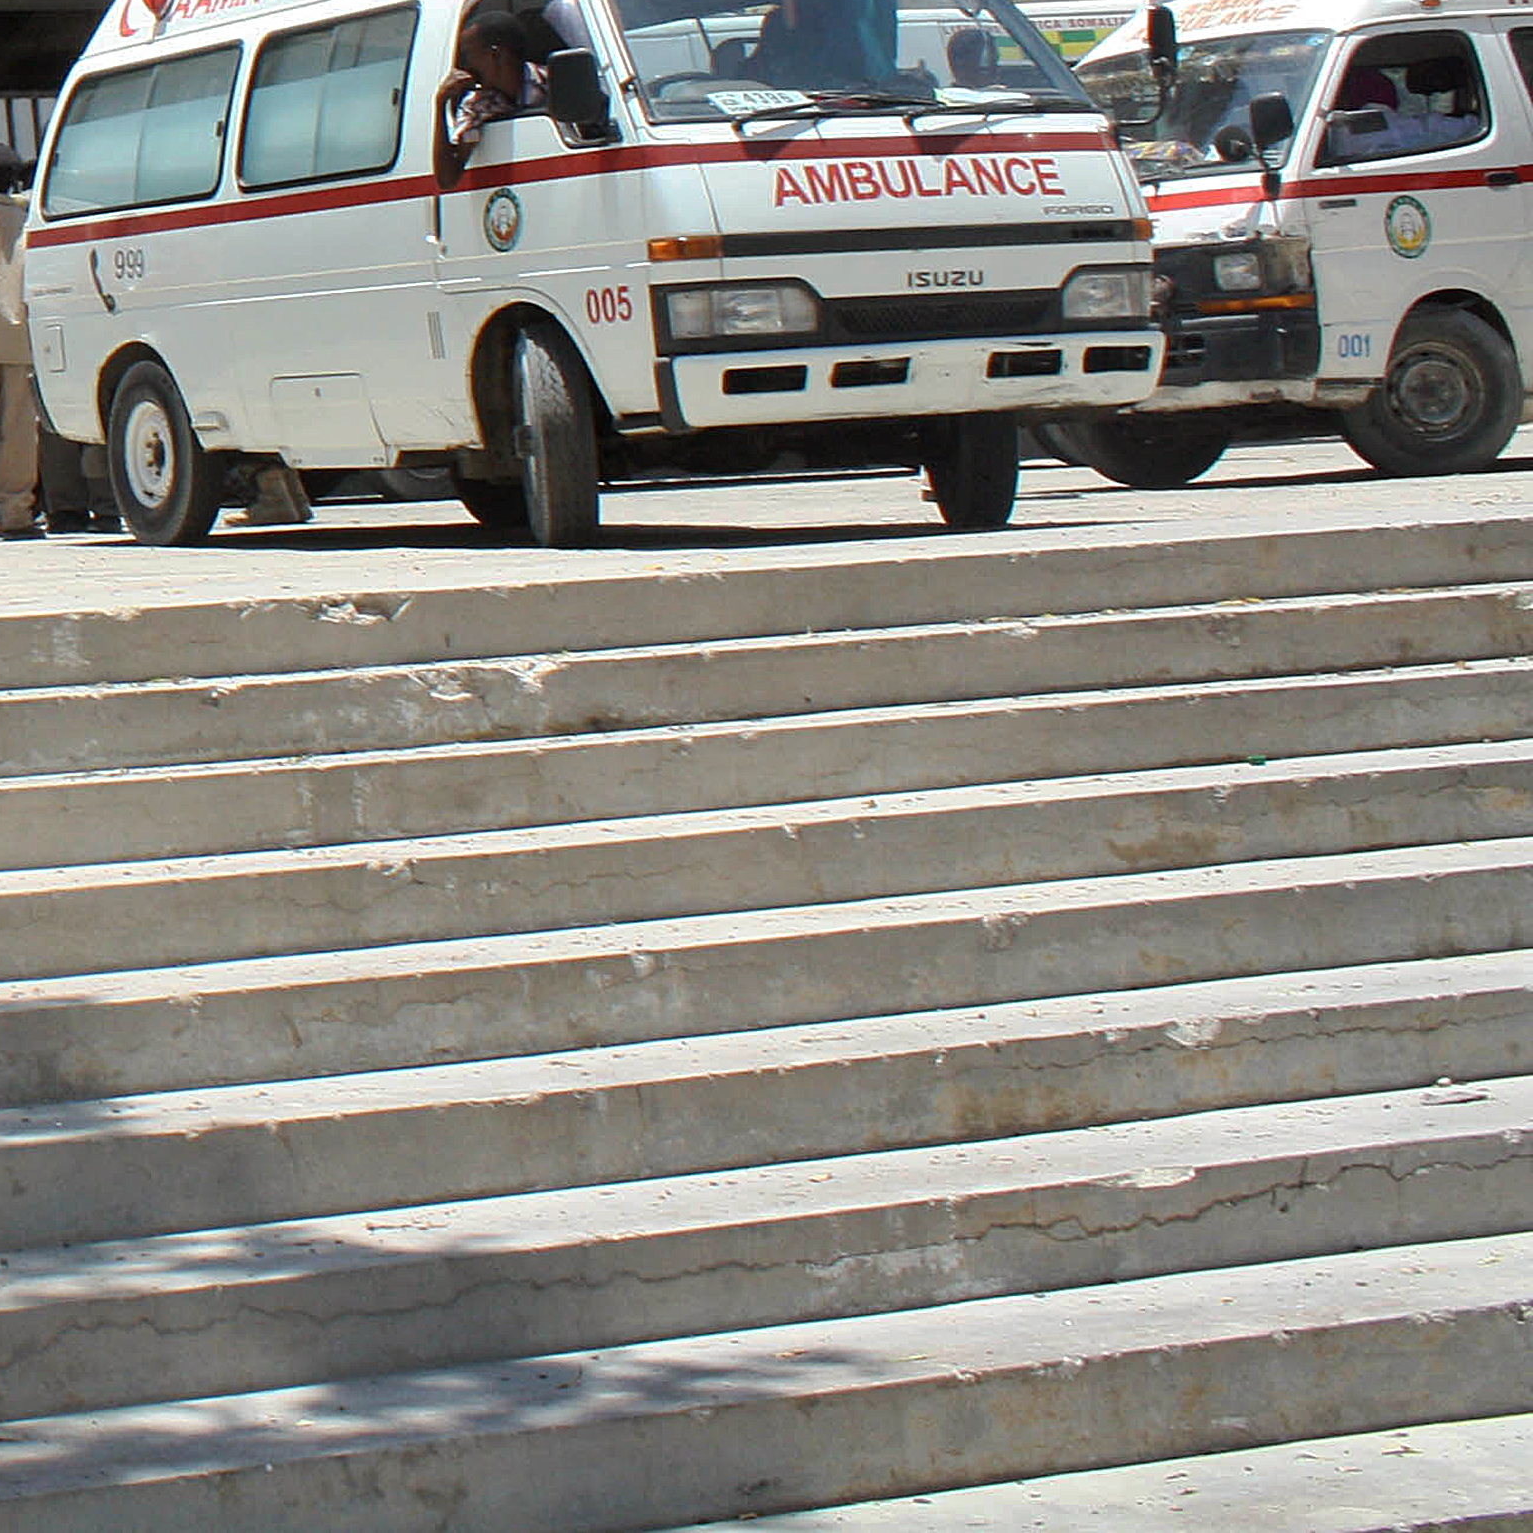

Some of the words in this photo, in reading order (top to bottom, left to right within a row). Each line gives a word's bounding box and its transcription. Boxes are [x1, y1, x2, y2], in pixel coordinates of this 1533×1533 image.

[774, 157, 1065, 207] AMBULANCE
[114, 249, 144, 279] 999
[906, 270, 985, 288] ISUZU
[586, 285, 633, 324] 005
[1338, 334, 1370, 358] 001
